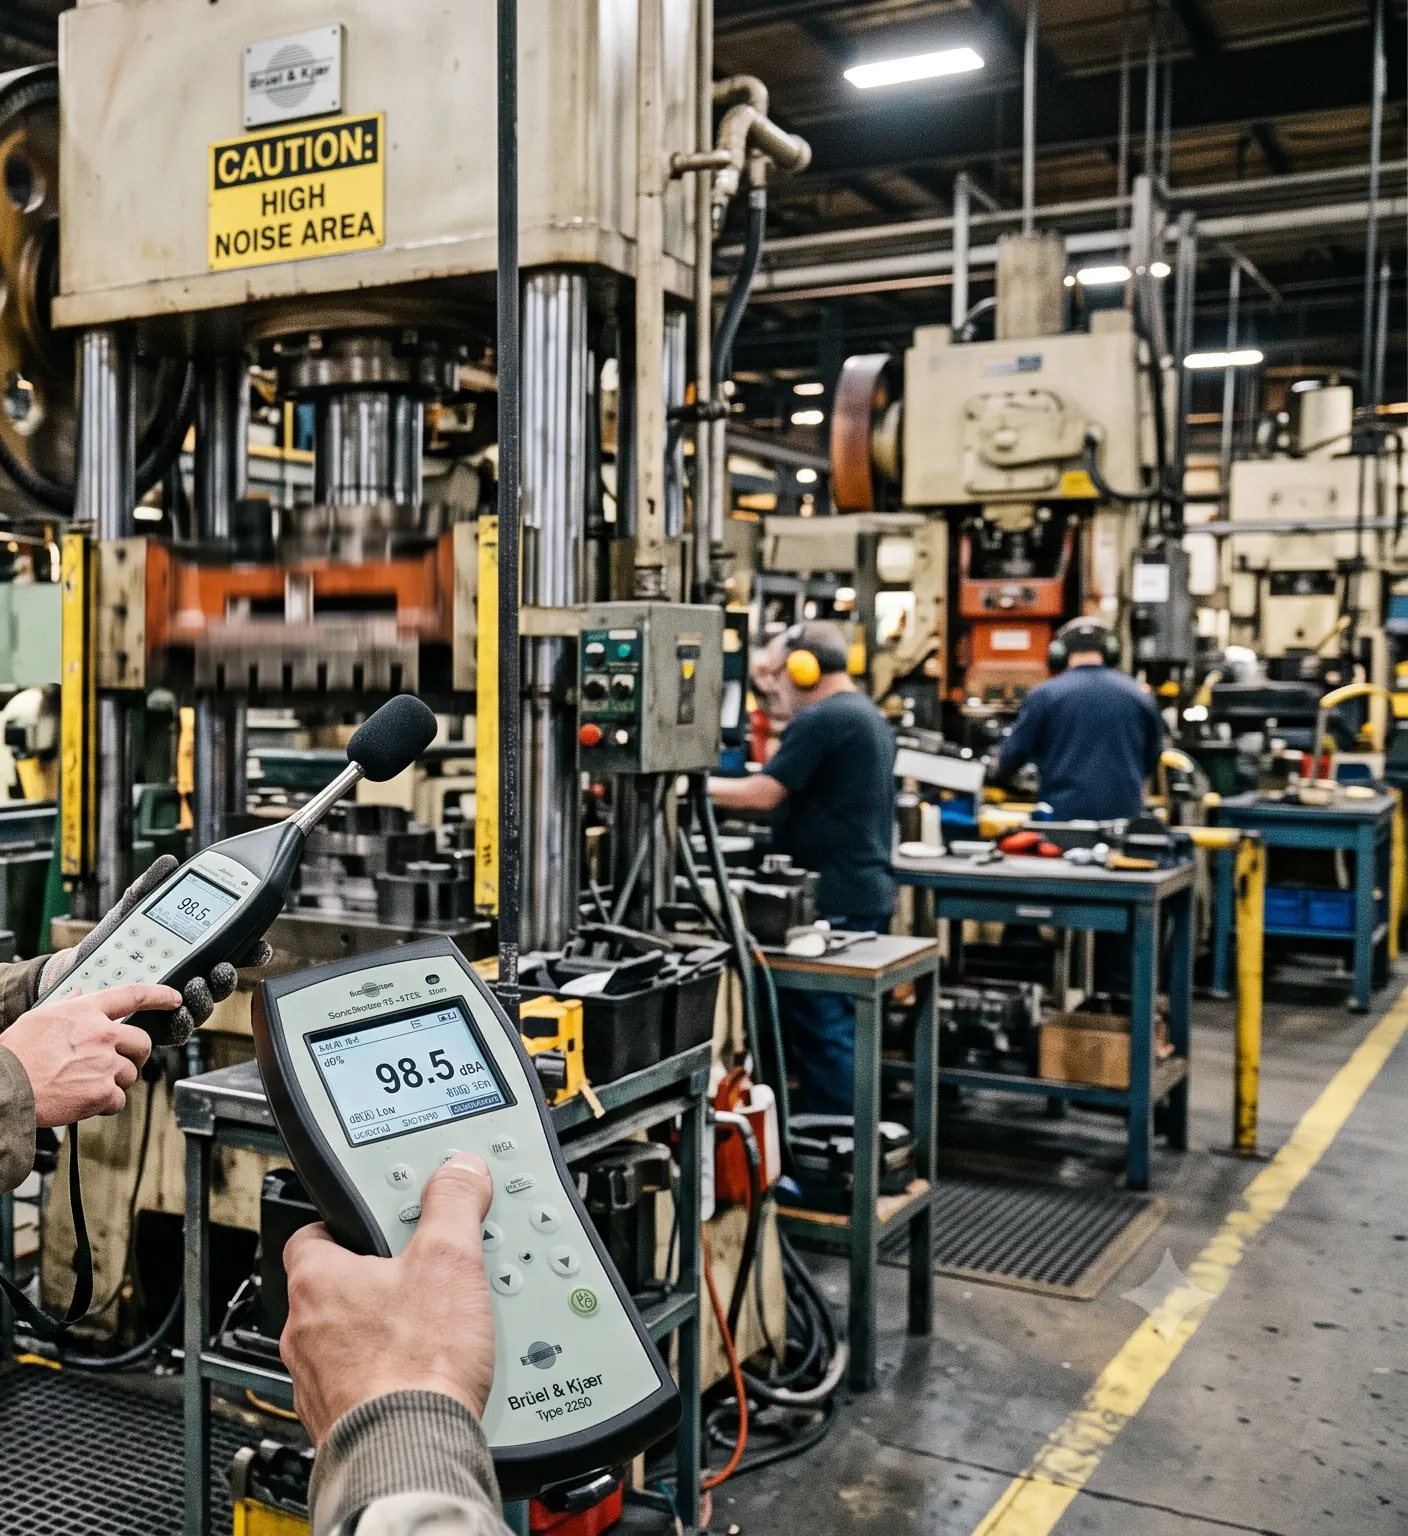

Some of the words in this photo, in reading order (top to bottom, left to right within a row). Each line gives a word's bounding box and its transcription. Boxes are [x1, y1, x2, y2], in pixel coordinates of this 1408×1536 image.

[217, 126, 374, 184] CAUTION:
[262, 183, 326, 216] HIGH
[215, 223, 292, 258] NOISE
[301, 211, 375, 245] AREA
[177, 897, 210, 921] 98.5
[375, 1048, 455, 1094] 98.5
[459, 1061, 485, 1076] dBA
[508, 1387, 550, 1410] Brüel
[552, 1383, 565, 1397] &
[566, 1373, 603, 1395] Kjær
[535, 1407, 564, 1422] Type
[564, 1396, 592, 1413] 2250
